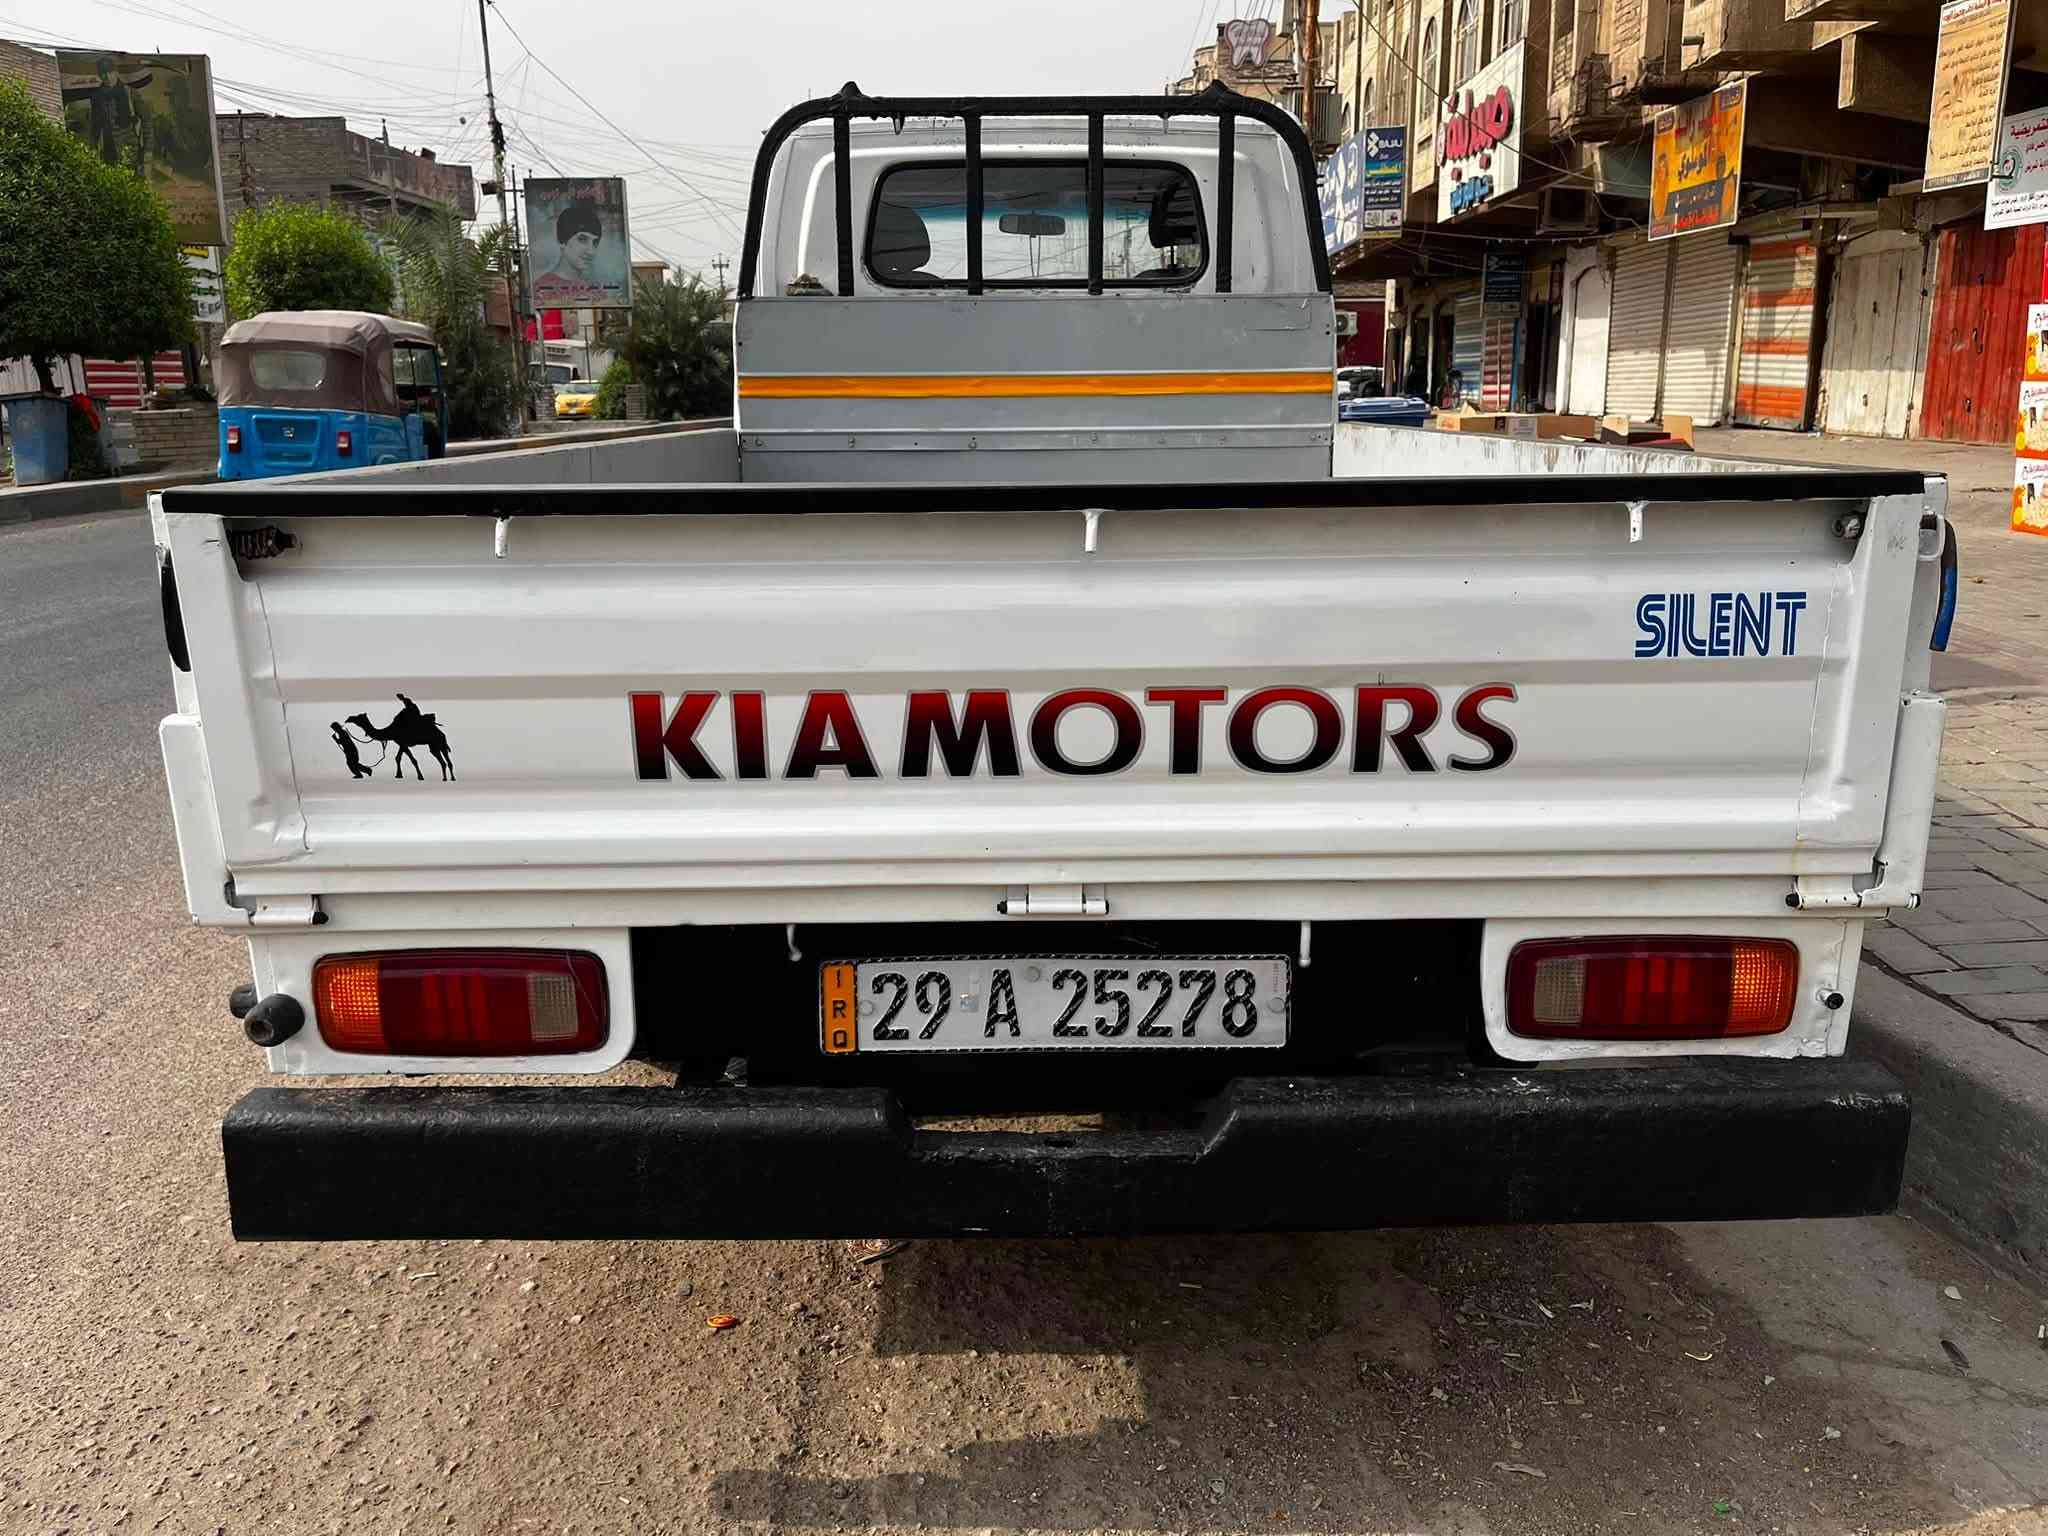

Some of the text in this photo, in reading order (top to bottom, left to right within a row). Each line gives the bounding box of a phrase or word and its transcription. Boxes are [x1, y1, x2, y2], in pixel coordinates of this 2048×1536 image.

[1635, 592, 1807, 658] SILENT
[871, 970, 952, 1041] 29
[984, 968, 1022, 1039] A
[1052, 968, 1259, 1038] 25278
